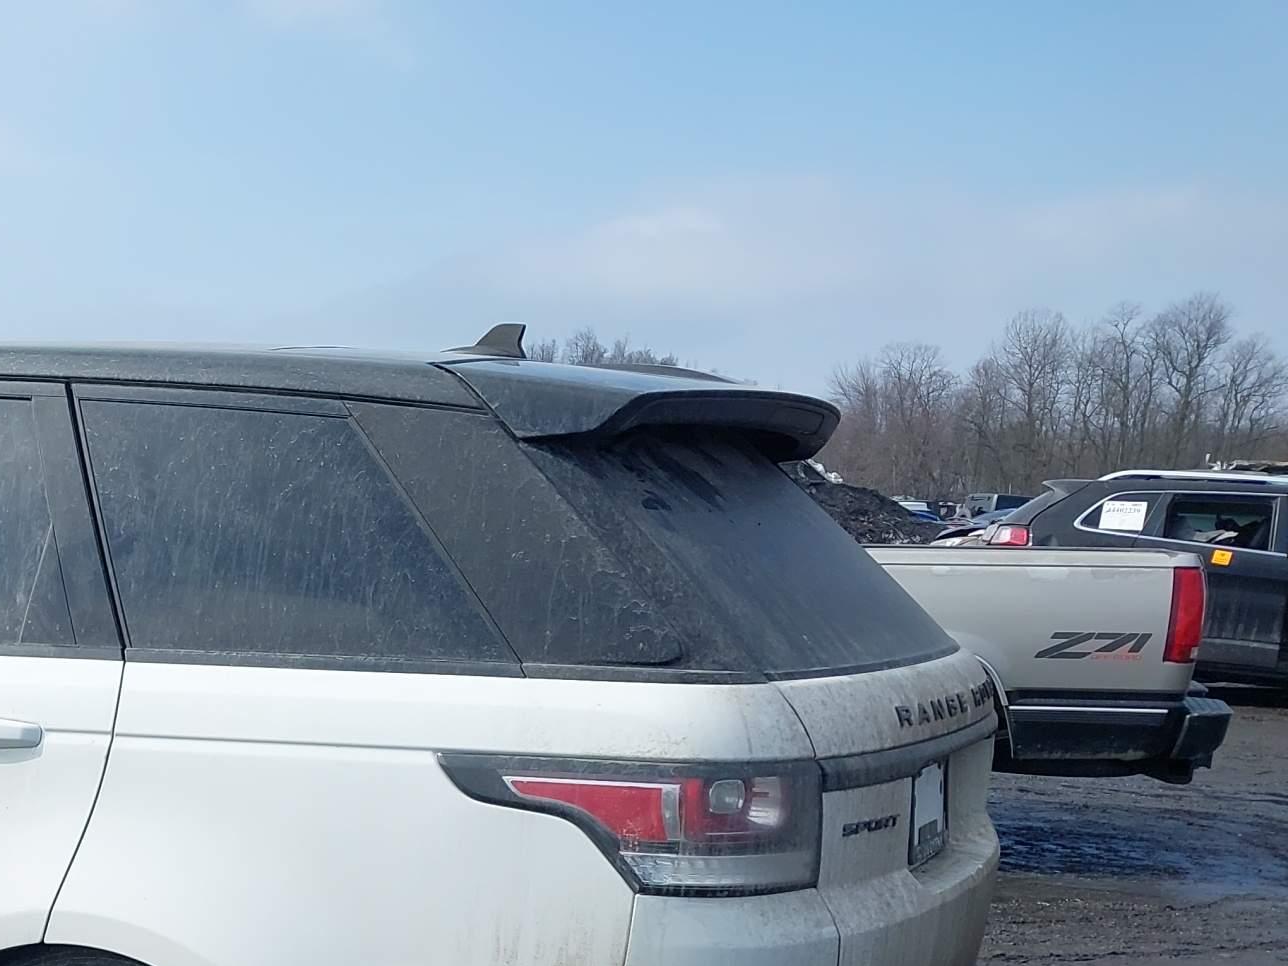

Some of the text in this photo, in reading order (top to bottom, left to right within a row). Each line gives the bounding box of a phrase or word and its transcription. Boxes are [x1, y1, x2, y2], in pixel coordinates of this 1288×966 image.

[1034, 631, 1153, 659] Z71
[894, 693, 968, 727] RANGE
[842, 814, 900, 837] SPORT
